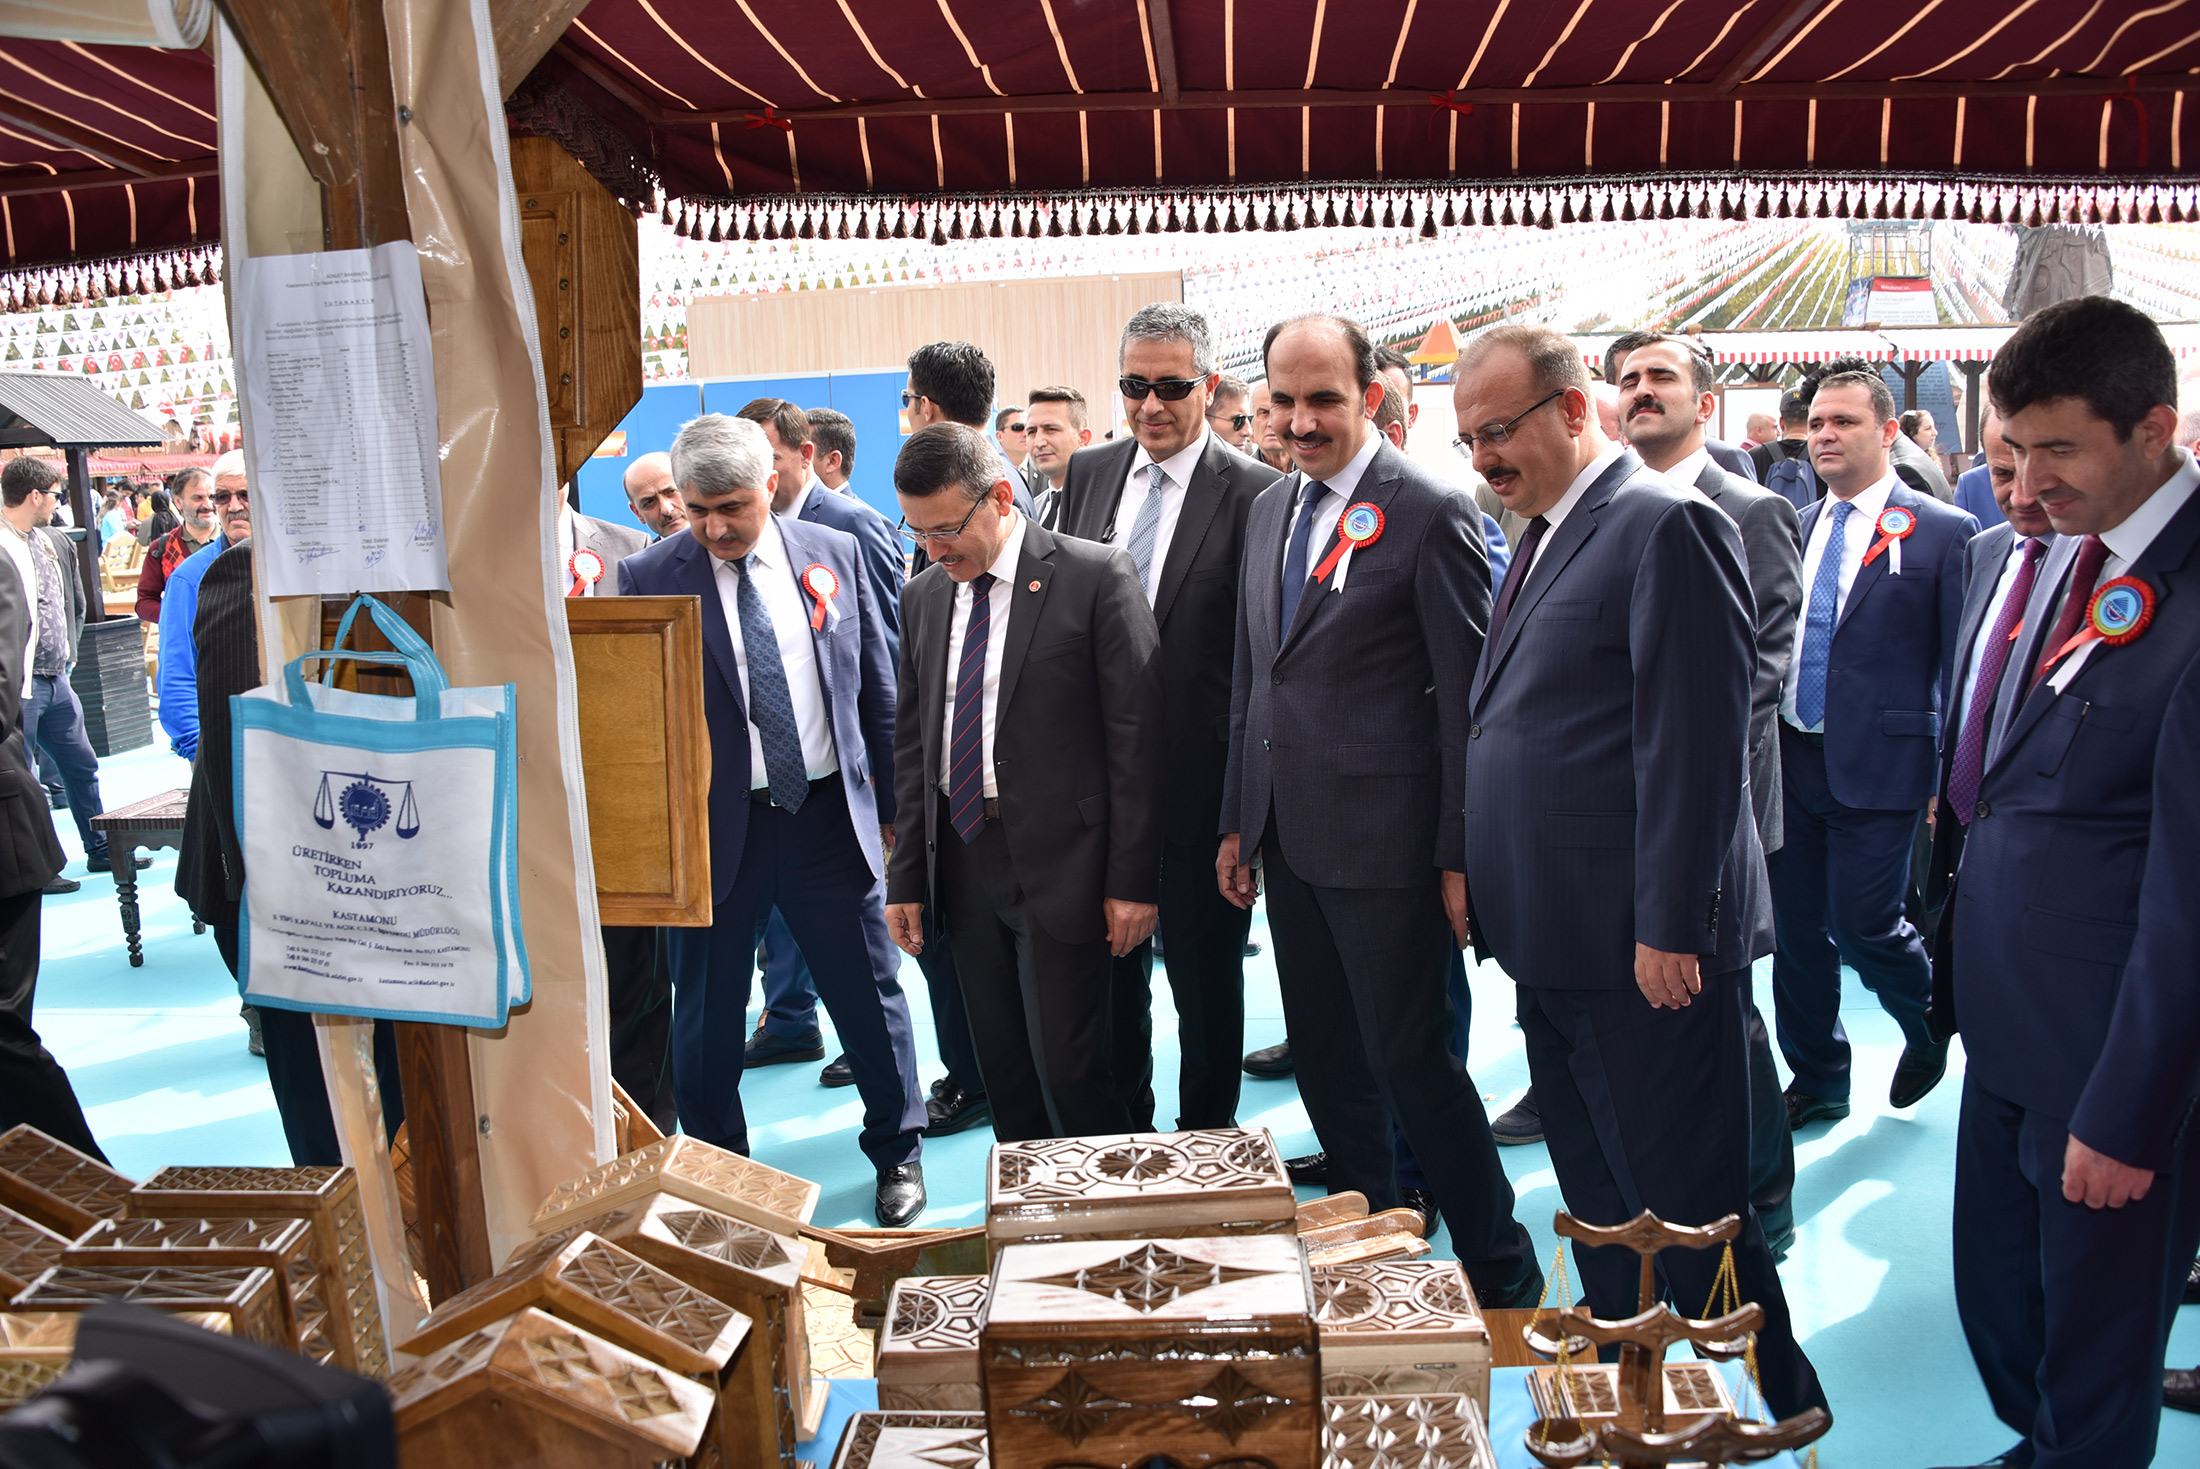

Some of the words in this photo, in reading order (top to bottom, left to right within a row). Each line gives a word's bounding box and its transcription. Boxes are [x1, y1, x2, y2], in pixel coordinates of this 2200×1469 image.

[351, 842, 374, 850] 1997
[292, 844, 362, 869] ÜRETİRKEN
[314, 865, 376, 885] TOPLUMA
[332, 910, 398, 926] KASTAMONU
